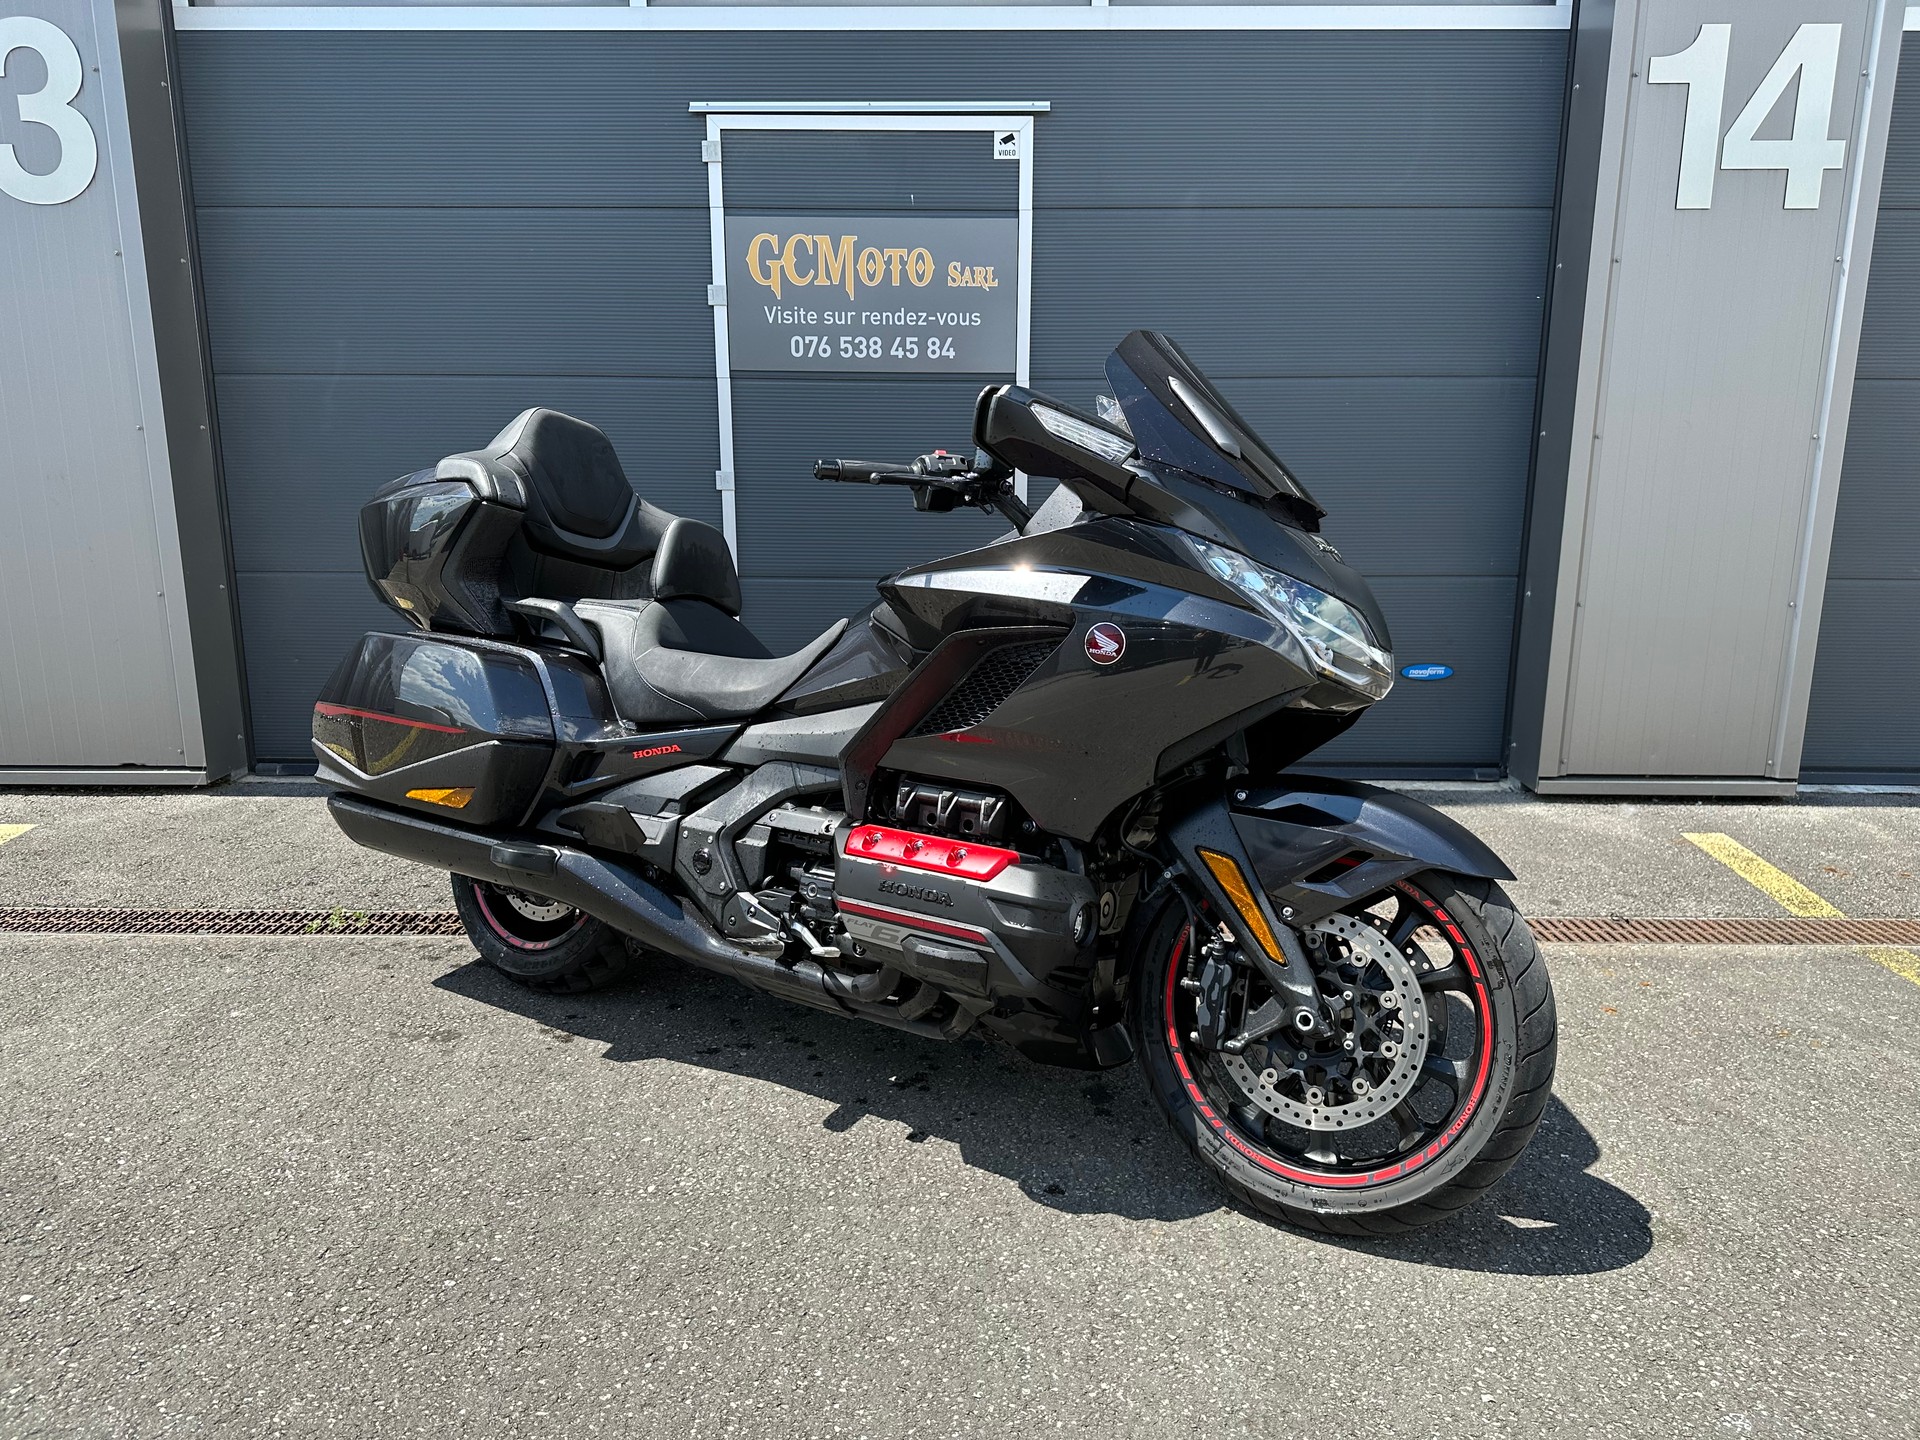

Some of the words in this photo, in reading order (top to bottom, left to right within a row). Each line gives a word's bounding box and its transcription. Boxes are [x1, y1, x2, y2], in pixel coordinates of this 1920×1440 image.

[0, 16, 98, 205] 3
[1647, 23, 1846, 209] 14
[998, 149, 1017, 157] VIDEO
[763, 306, 818, 325] Visite
[823, 310, 856, 326] sur
[861, 307, 982, 327] rendez-vous
[790, 335, 832, 359] 076
[839, 336, 883, 359] 538
[890, 337, 919, 360] 45
[926, 337, 956, 360] 84
[1088, 648, 1118, 657] HONDA
[632, 744, 682, 759] HONDA
[879, 880, 954, 907] HONDA
[846, 918, 875, 929] FLAT
[1447, 1095, 1478, 1135] HONDA
[1225, 1128, 1262, 1161] HONDA
